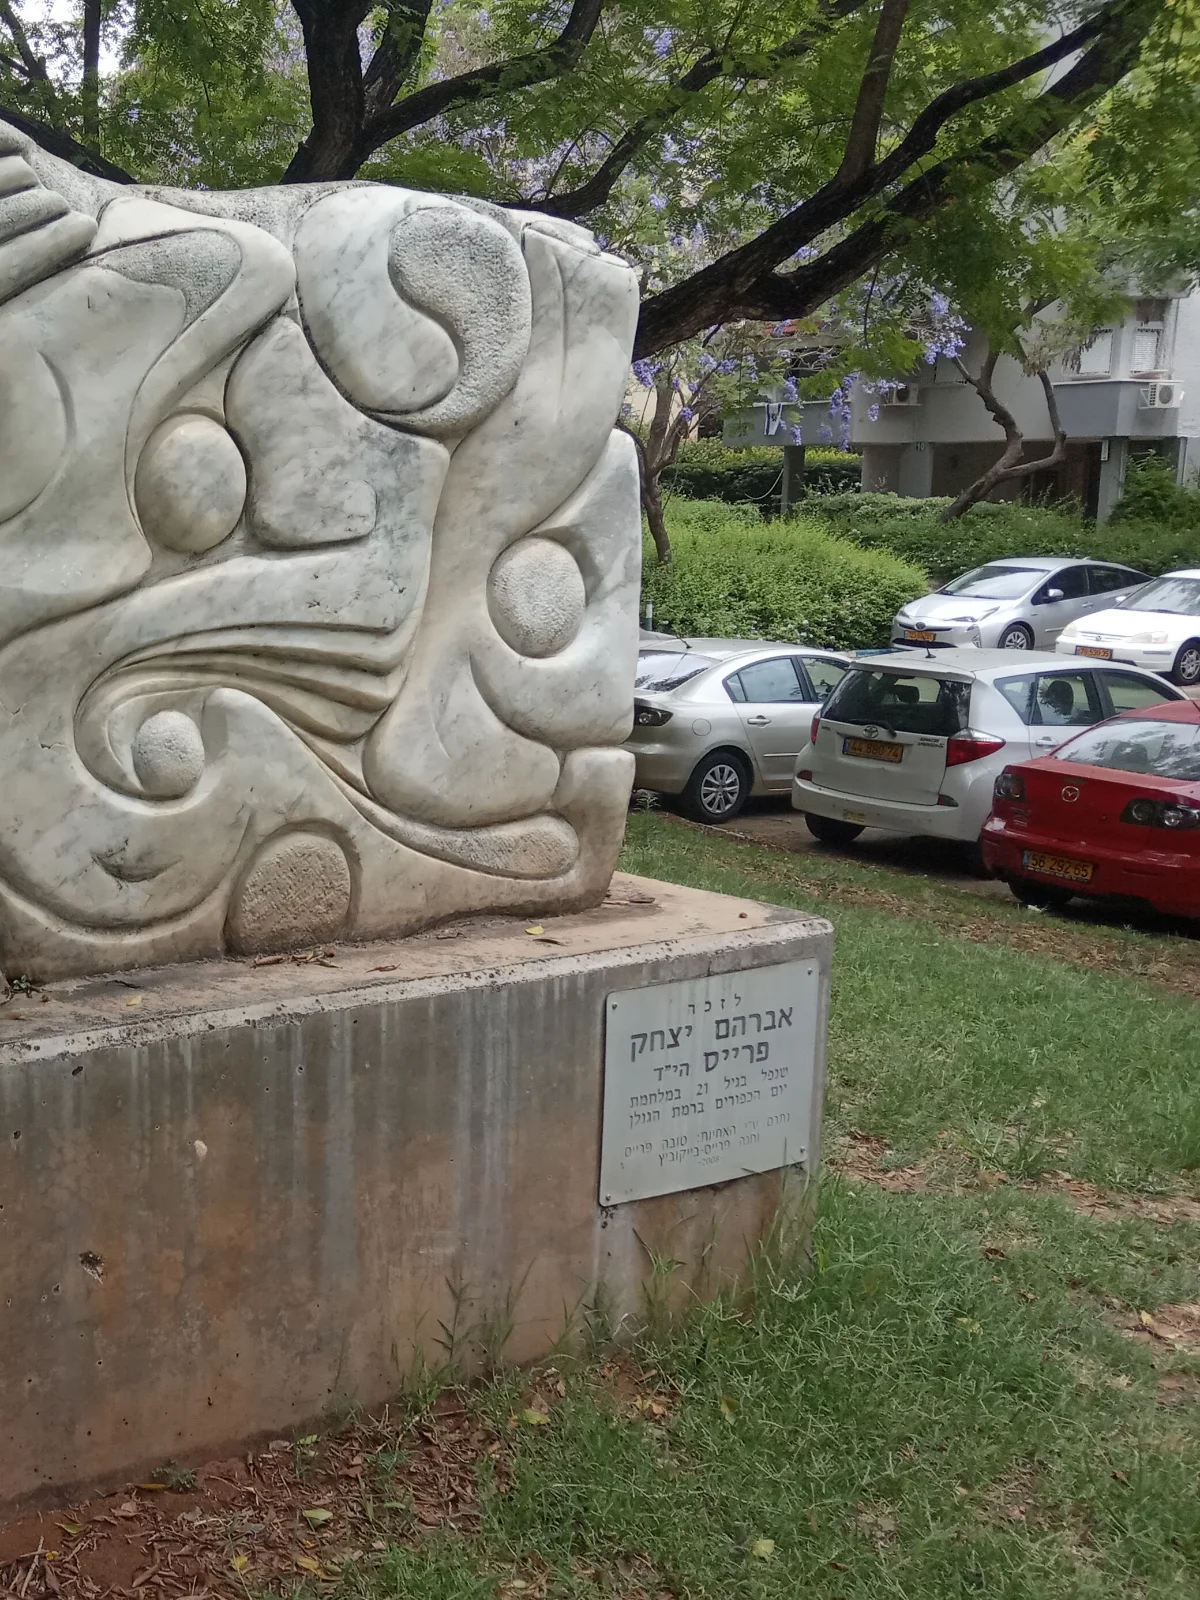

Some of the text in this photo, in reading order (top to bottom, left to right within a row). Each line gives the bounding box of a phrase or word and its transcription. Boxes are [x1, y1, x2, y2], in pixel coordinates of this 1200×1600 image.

[630, 1006, 793, 1062] אברהם יצחק
[703, 1041, 769, 1072] פרייס
[630, 1066, 788, 1108] שנפל בגיל 21 במלחמת
[629, 1083, 788, 1129] יום הכפורים ברמת הגולן
[624, 1142, 653, 1157] פרייס
[662, 1135, 687, 1150] טובה
